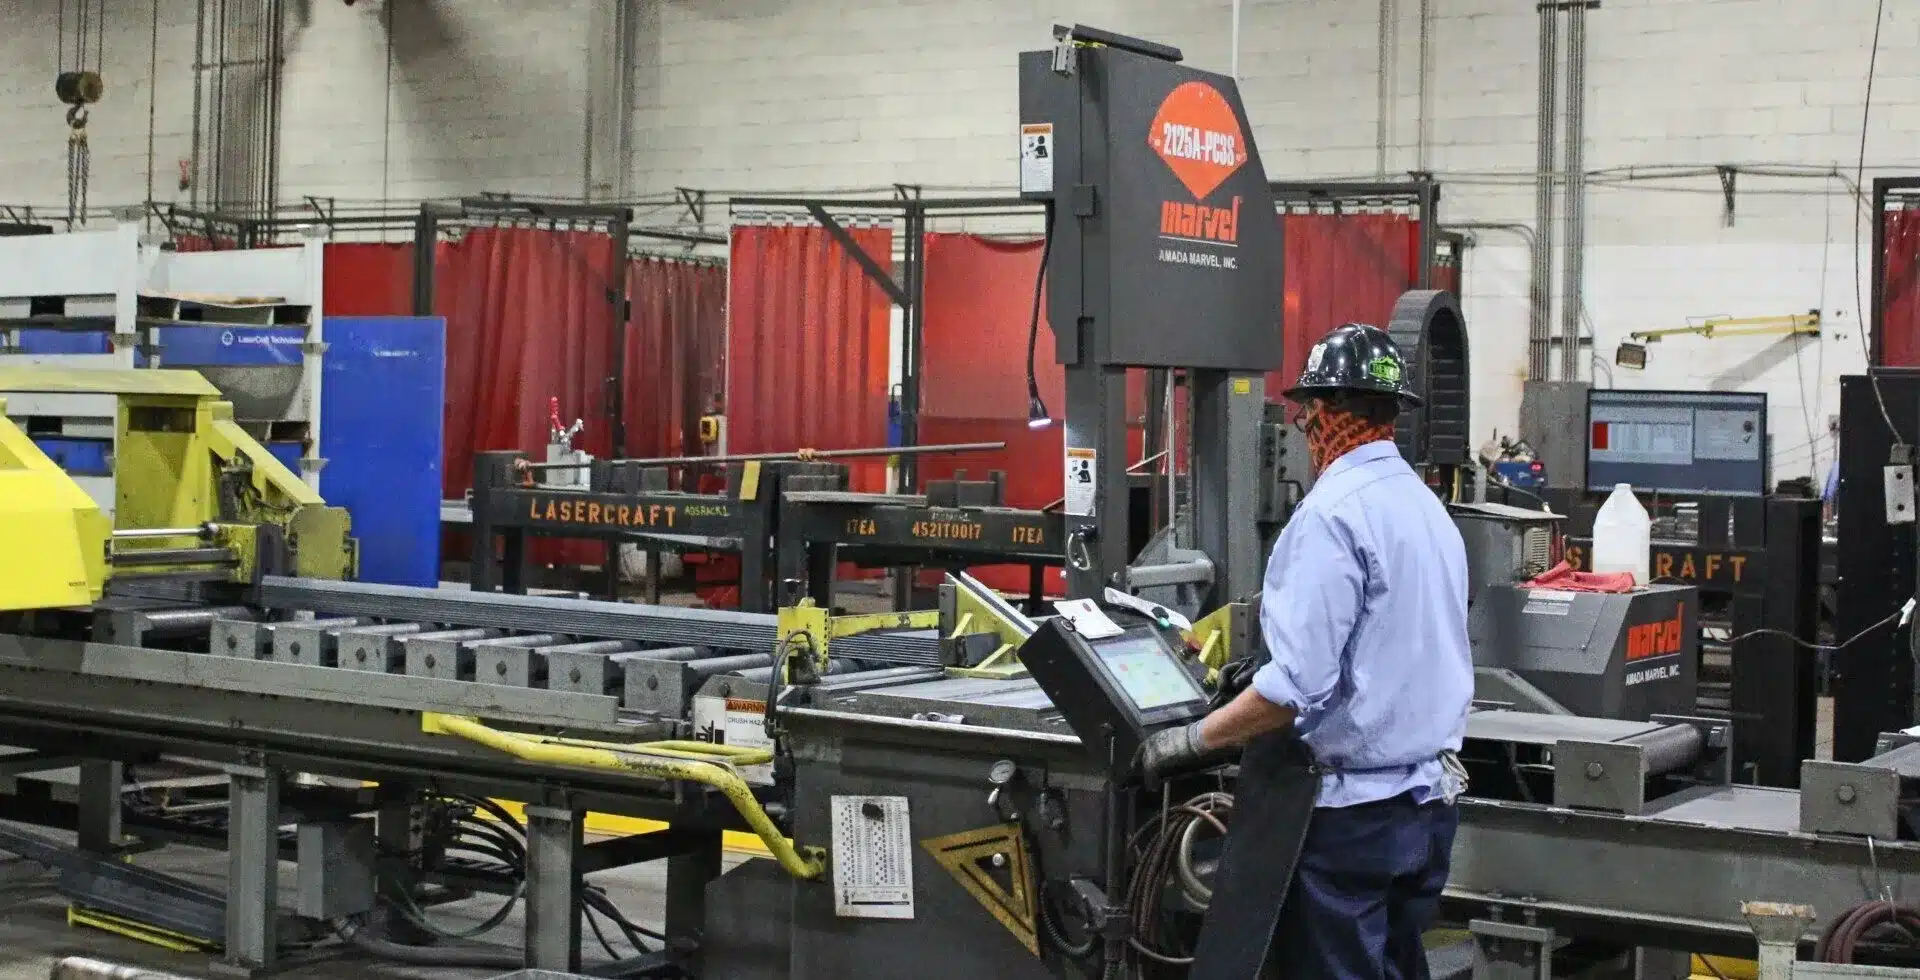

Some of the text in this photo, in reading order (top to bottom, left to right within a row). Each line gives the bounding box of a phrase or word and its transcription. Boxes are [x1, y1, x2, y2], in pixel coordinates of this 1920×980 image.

[1161, 196, 1240, 241] marvel
[1159, 250, 1238, 269] AMADA MARVEL, INC.
[530, 498, 677, 527] LASERCRAFT
[912, 522, 982, 539] 4521T0017
[1012, 526, 1044, 544] 17EA
[1627, 602, 1684, 660] marvel
[1625, 671, 1645, 686] AMADA
[734, 702, 766, 713] WARNIN
